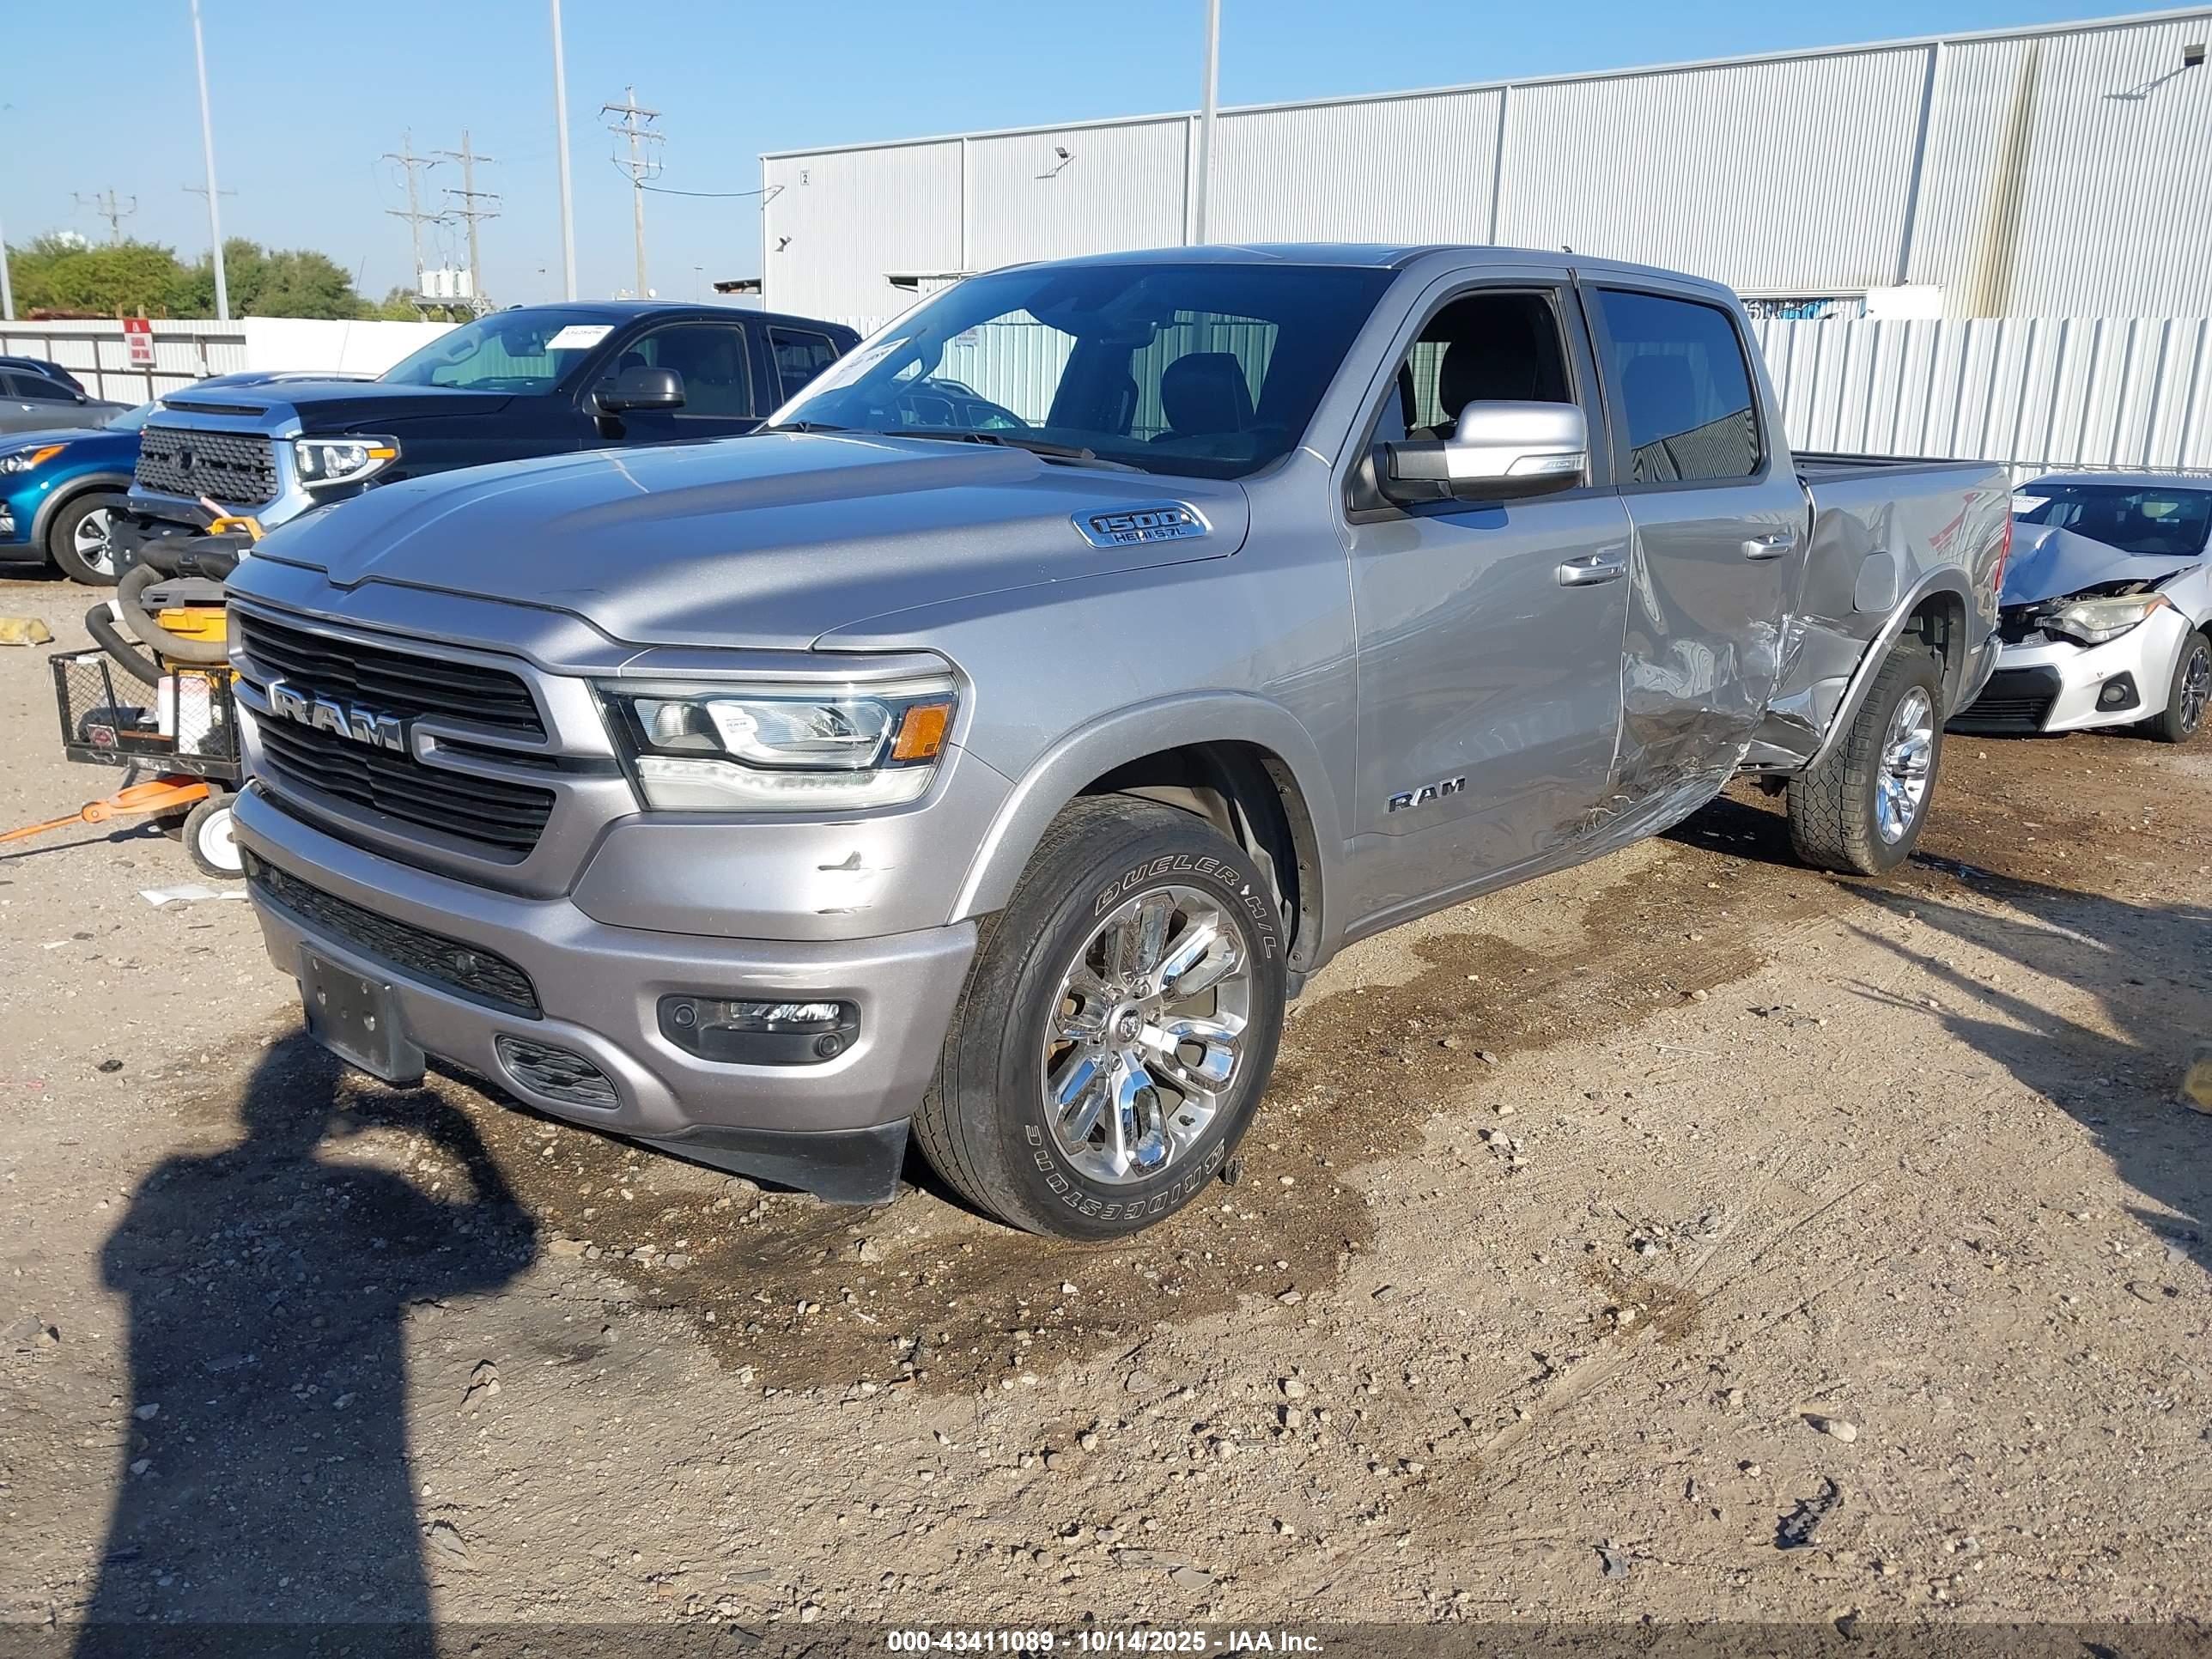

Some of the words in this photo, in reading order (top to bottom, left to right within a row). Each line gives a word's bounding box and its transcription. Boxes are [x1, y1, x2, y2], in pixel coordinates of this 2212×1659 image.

[1091, 511, 1185, 535] 1500
[1115, 531, 1153, 544] HEMI
[1157, 526, 1187, 539] 5.7L
[268, 679, 406, 753] RAM
[1383, 775, 1466, 815] RAM
[1095, 854, 1240, 917] DUELER
[1024, 1123, 1225, 1221] BRIDGESTONE
